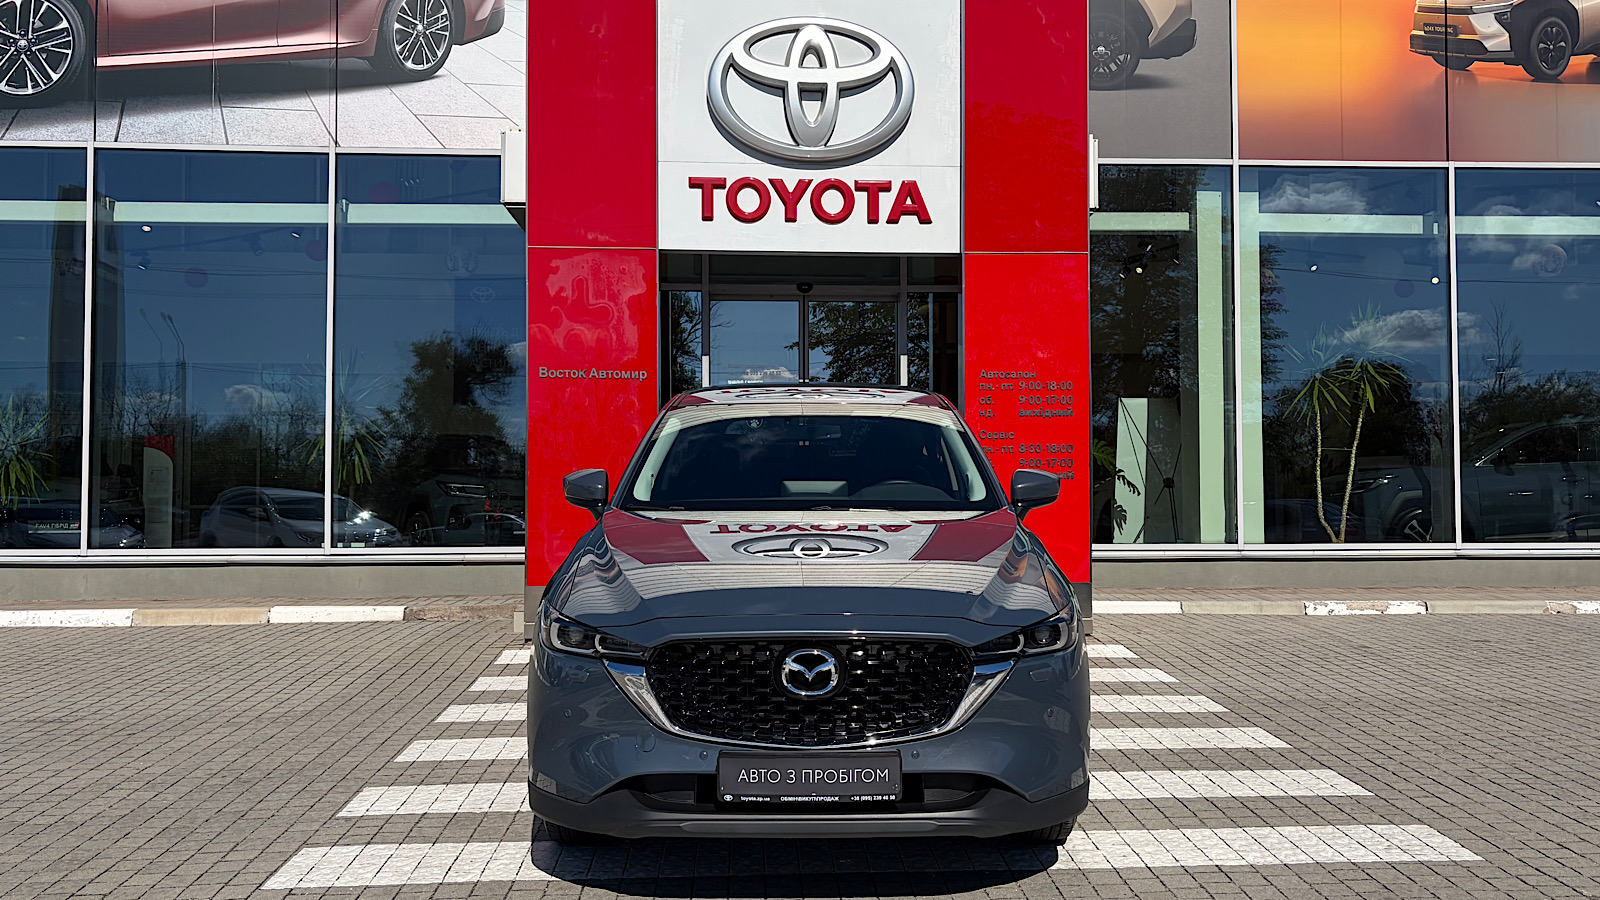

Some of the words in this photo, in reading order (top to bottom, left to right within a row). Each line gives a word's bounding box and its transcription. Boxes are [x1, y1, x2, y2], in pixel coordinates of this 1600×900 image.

[688, 176, 932, 225] TOYOTA
[539, 366, 587, 379] Восток
[589, 368, 648, 382] Автомир
[980, 369, 1037, 379] Автосалон
[1019, 381, 1074, 391] 9:00-18:00
[980, 395, 995, 405] сб.
[1019, 395, 1074, 405] 9:00-17:00
[980, 409, 995, 418] нд.
[1019, 407, 1074, 418] вихідний
[980, 430, 1015, 441] Сервіс
[1019, 444, 1074, 454] 8:30-18:00
[1019, 458, 1074, 468] 9:00-17:00
[738, 769, 781, 784] АВТО
[802, 769, 890, 784] ПРОБІГОМ
